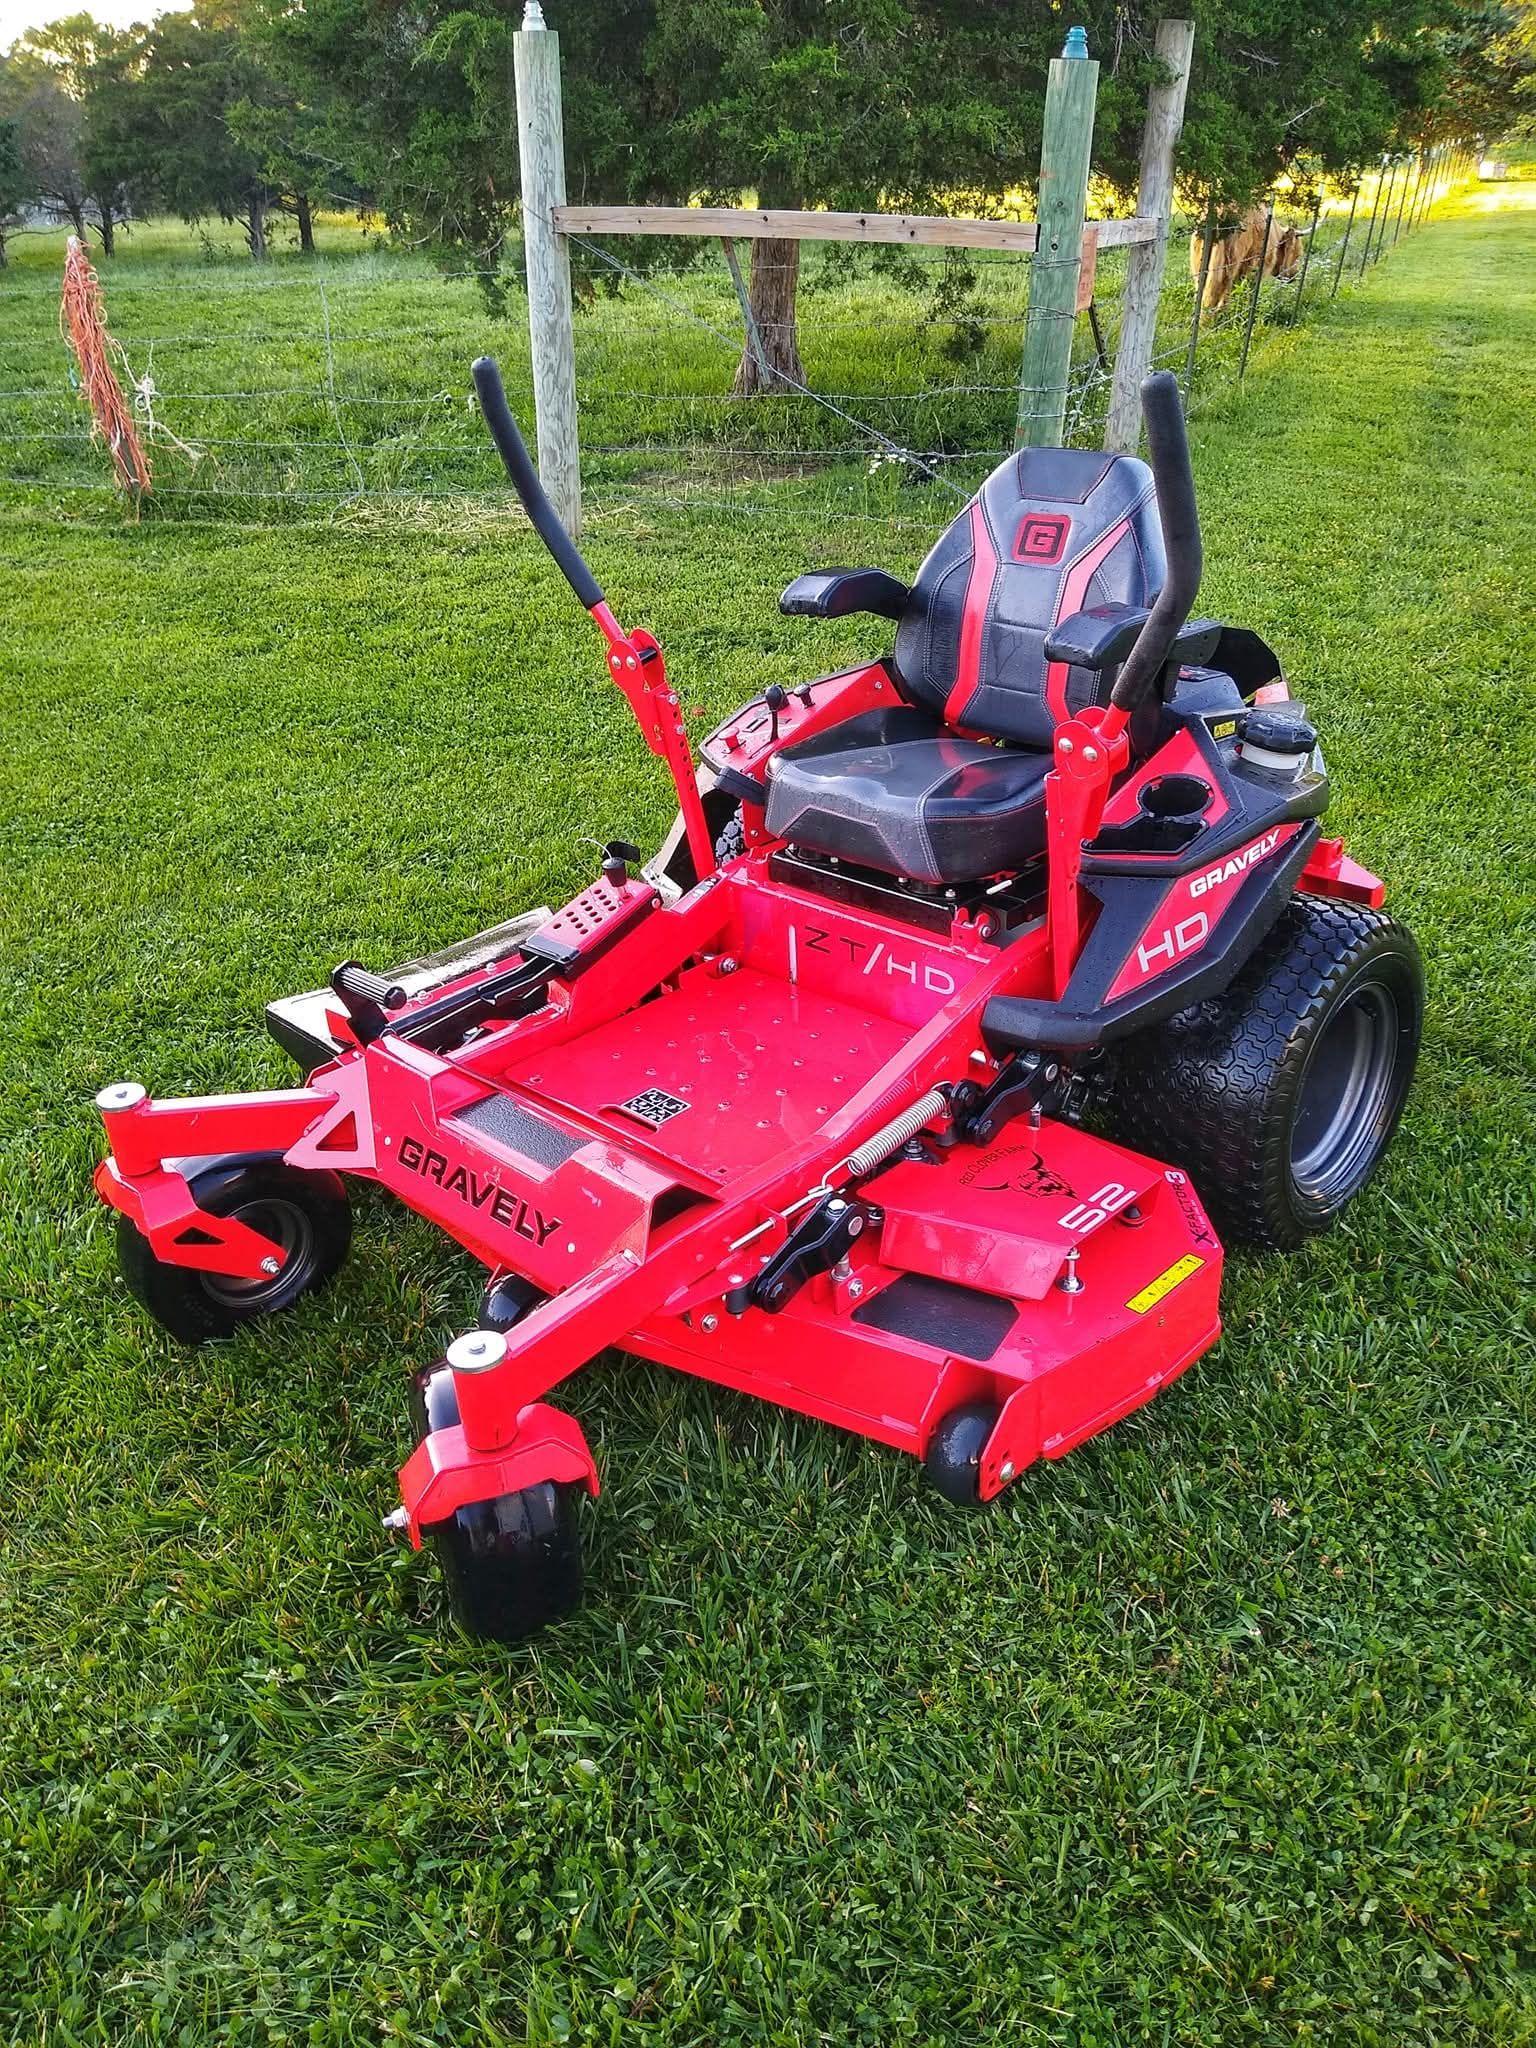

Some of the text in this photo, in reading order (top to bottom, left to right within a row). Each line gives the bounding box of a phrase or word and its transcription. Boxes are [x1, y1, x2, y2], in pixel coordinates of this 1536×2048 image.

[1189, 828, 1281, 898] GRAVELY
[1137, 911, 1209, 973] HD
[397, 1135, 563, 1249] GRAVELY
[1056, 1182, 1137, 1234] 52
